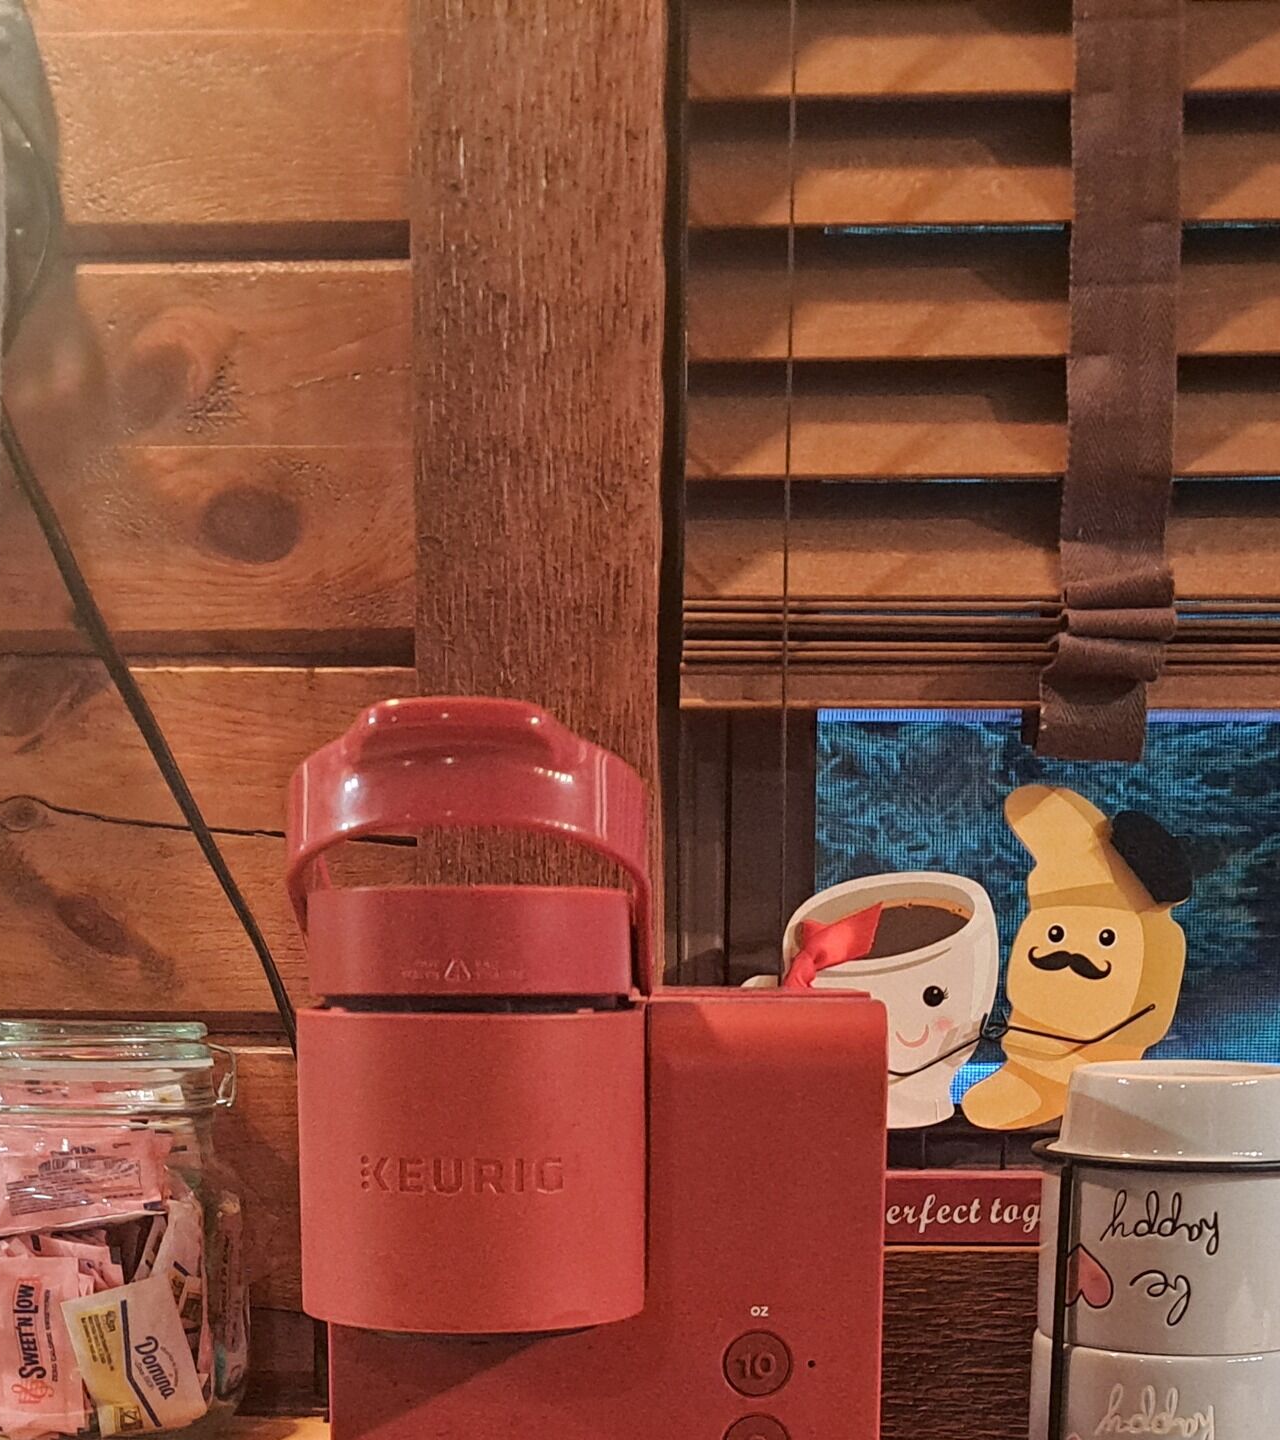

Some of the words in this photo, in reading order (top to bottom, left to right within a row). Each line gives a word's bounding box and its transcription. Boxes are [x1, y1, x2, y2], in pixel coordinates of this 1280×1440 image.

[360, 1156, 565, 1194] KEURIG
[1099, 1189, 1219, 1256] happy
[750, 1306, 769, 1317] OZ
[1129, 1269, 1191, 1327] be
[737, 1351, 777, 1380] 10
